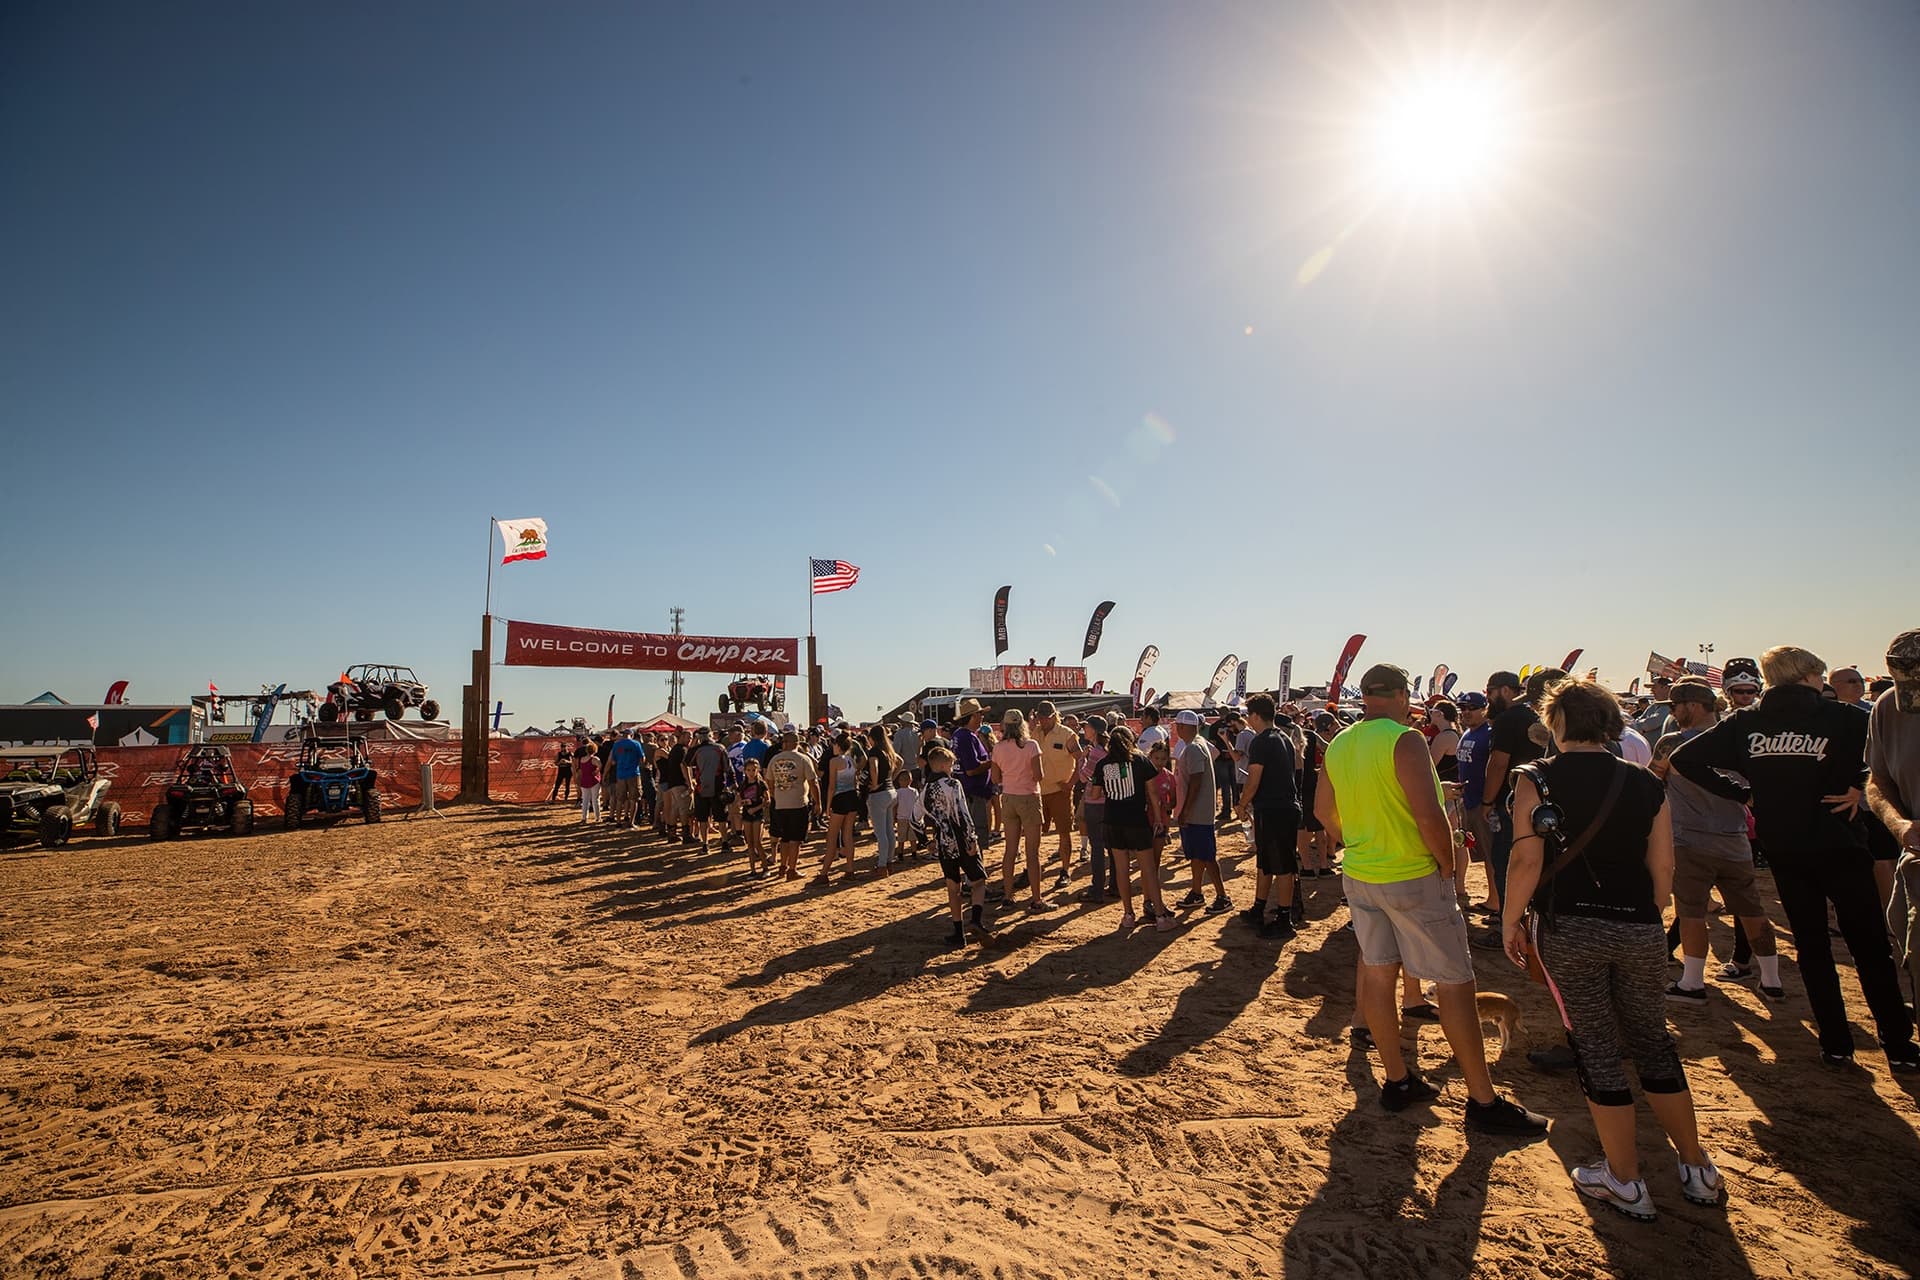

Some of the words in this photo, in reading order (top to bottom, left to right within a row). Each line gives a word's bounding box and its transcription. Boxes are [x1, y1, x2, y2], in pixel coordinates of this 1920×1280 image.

[519, 637, 634, 656] WELCOME
[642, 644, 668, 657] TO
[677, 642, 740, 665] CAMP
[740, 647, 791, 664] RZR
[1747, 731, 1829, 761] Buttery
